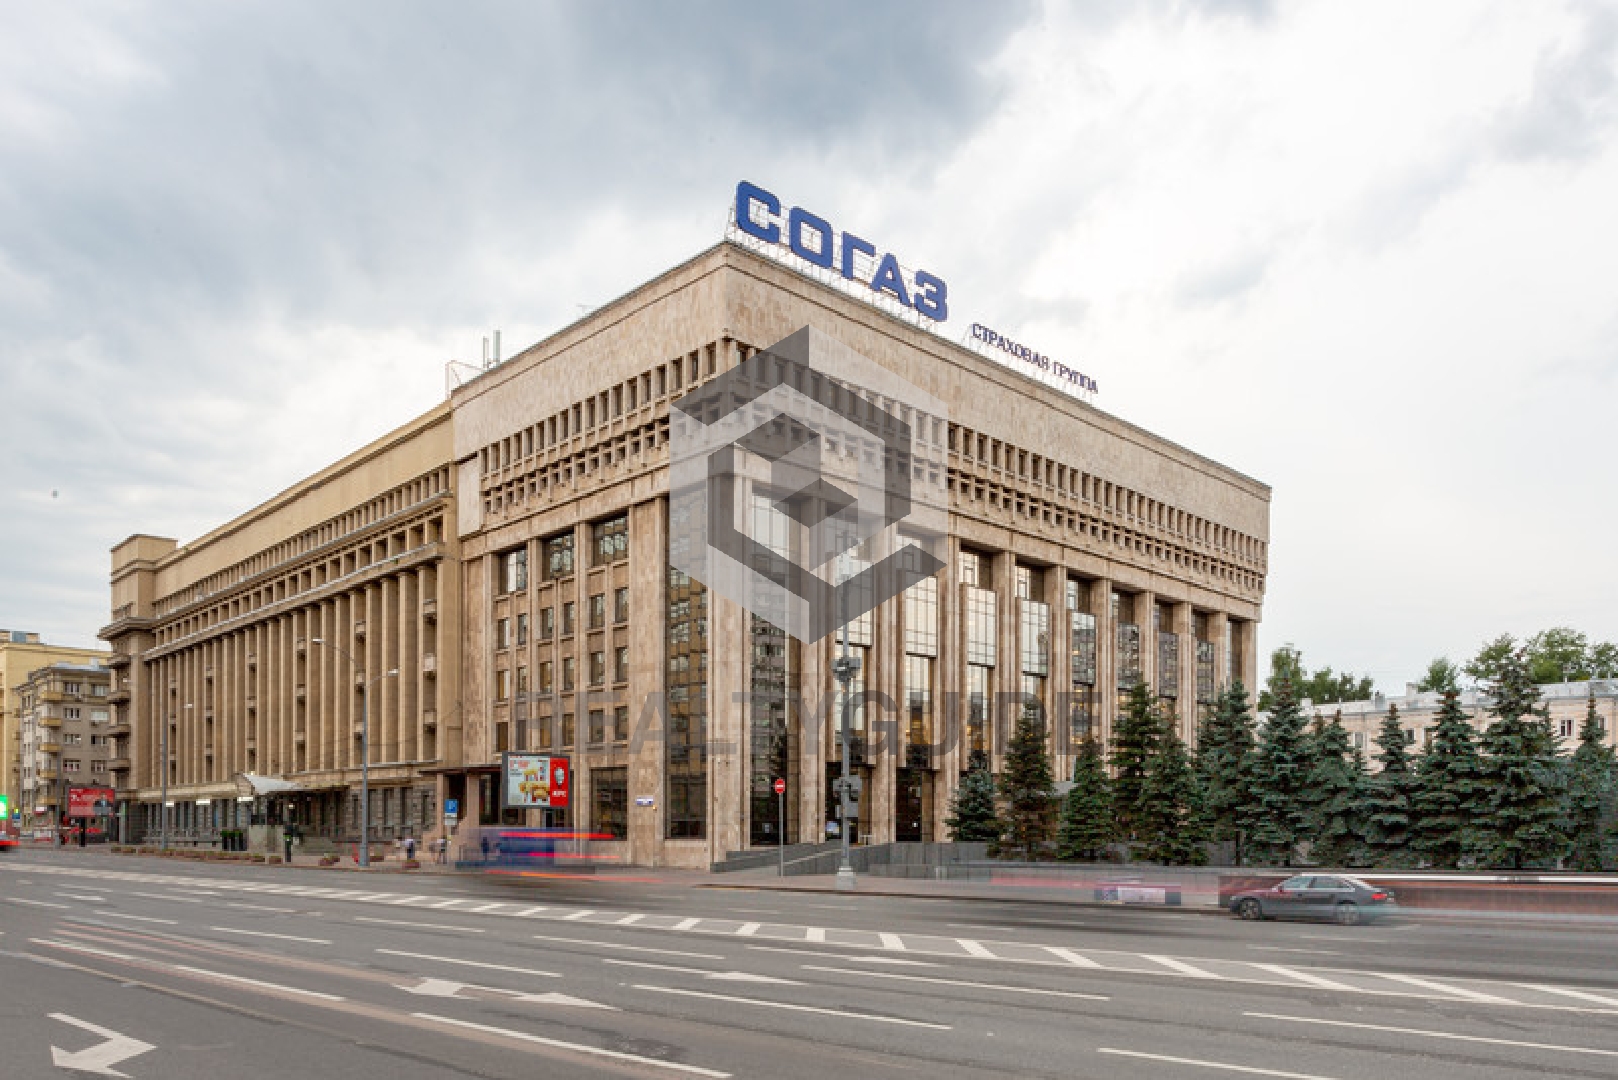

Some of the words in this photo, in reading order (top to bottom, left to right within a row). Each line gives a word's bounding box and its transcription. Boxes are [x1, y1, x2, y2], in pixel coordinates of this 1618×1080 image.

[736, 180, 948, 322] СОГАЗ
[972, 323, 1049, 371] СТРАХОВАЯ
[1052, 361, 1098, 394] ГРУППА
